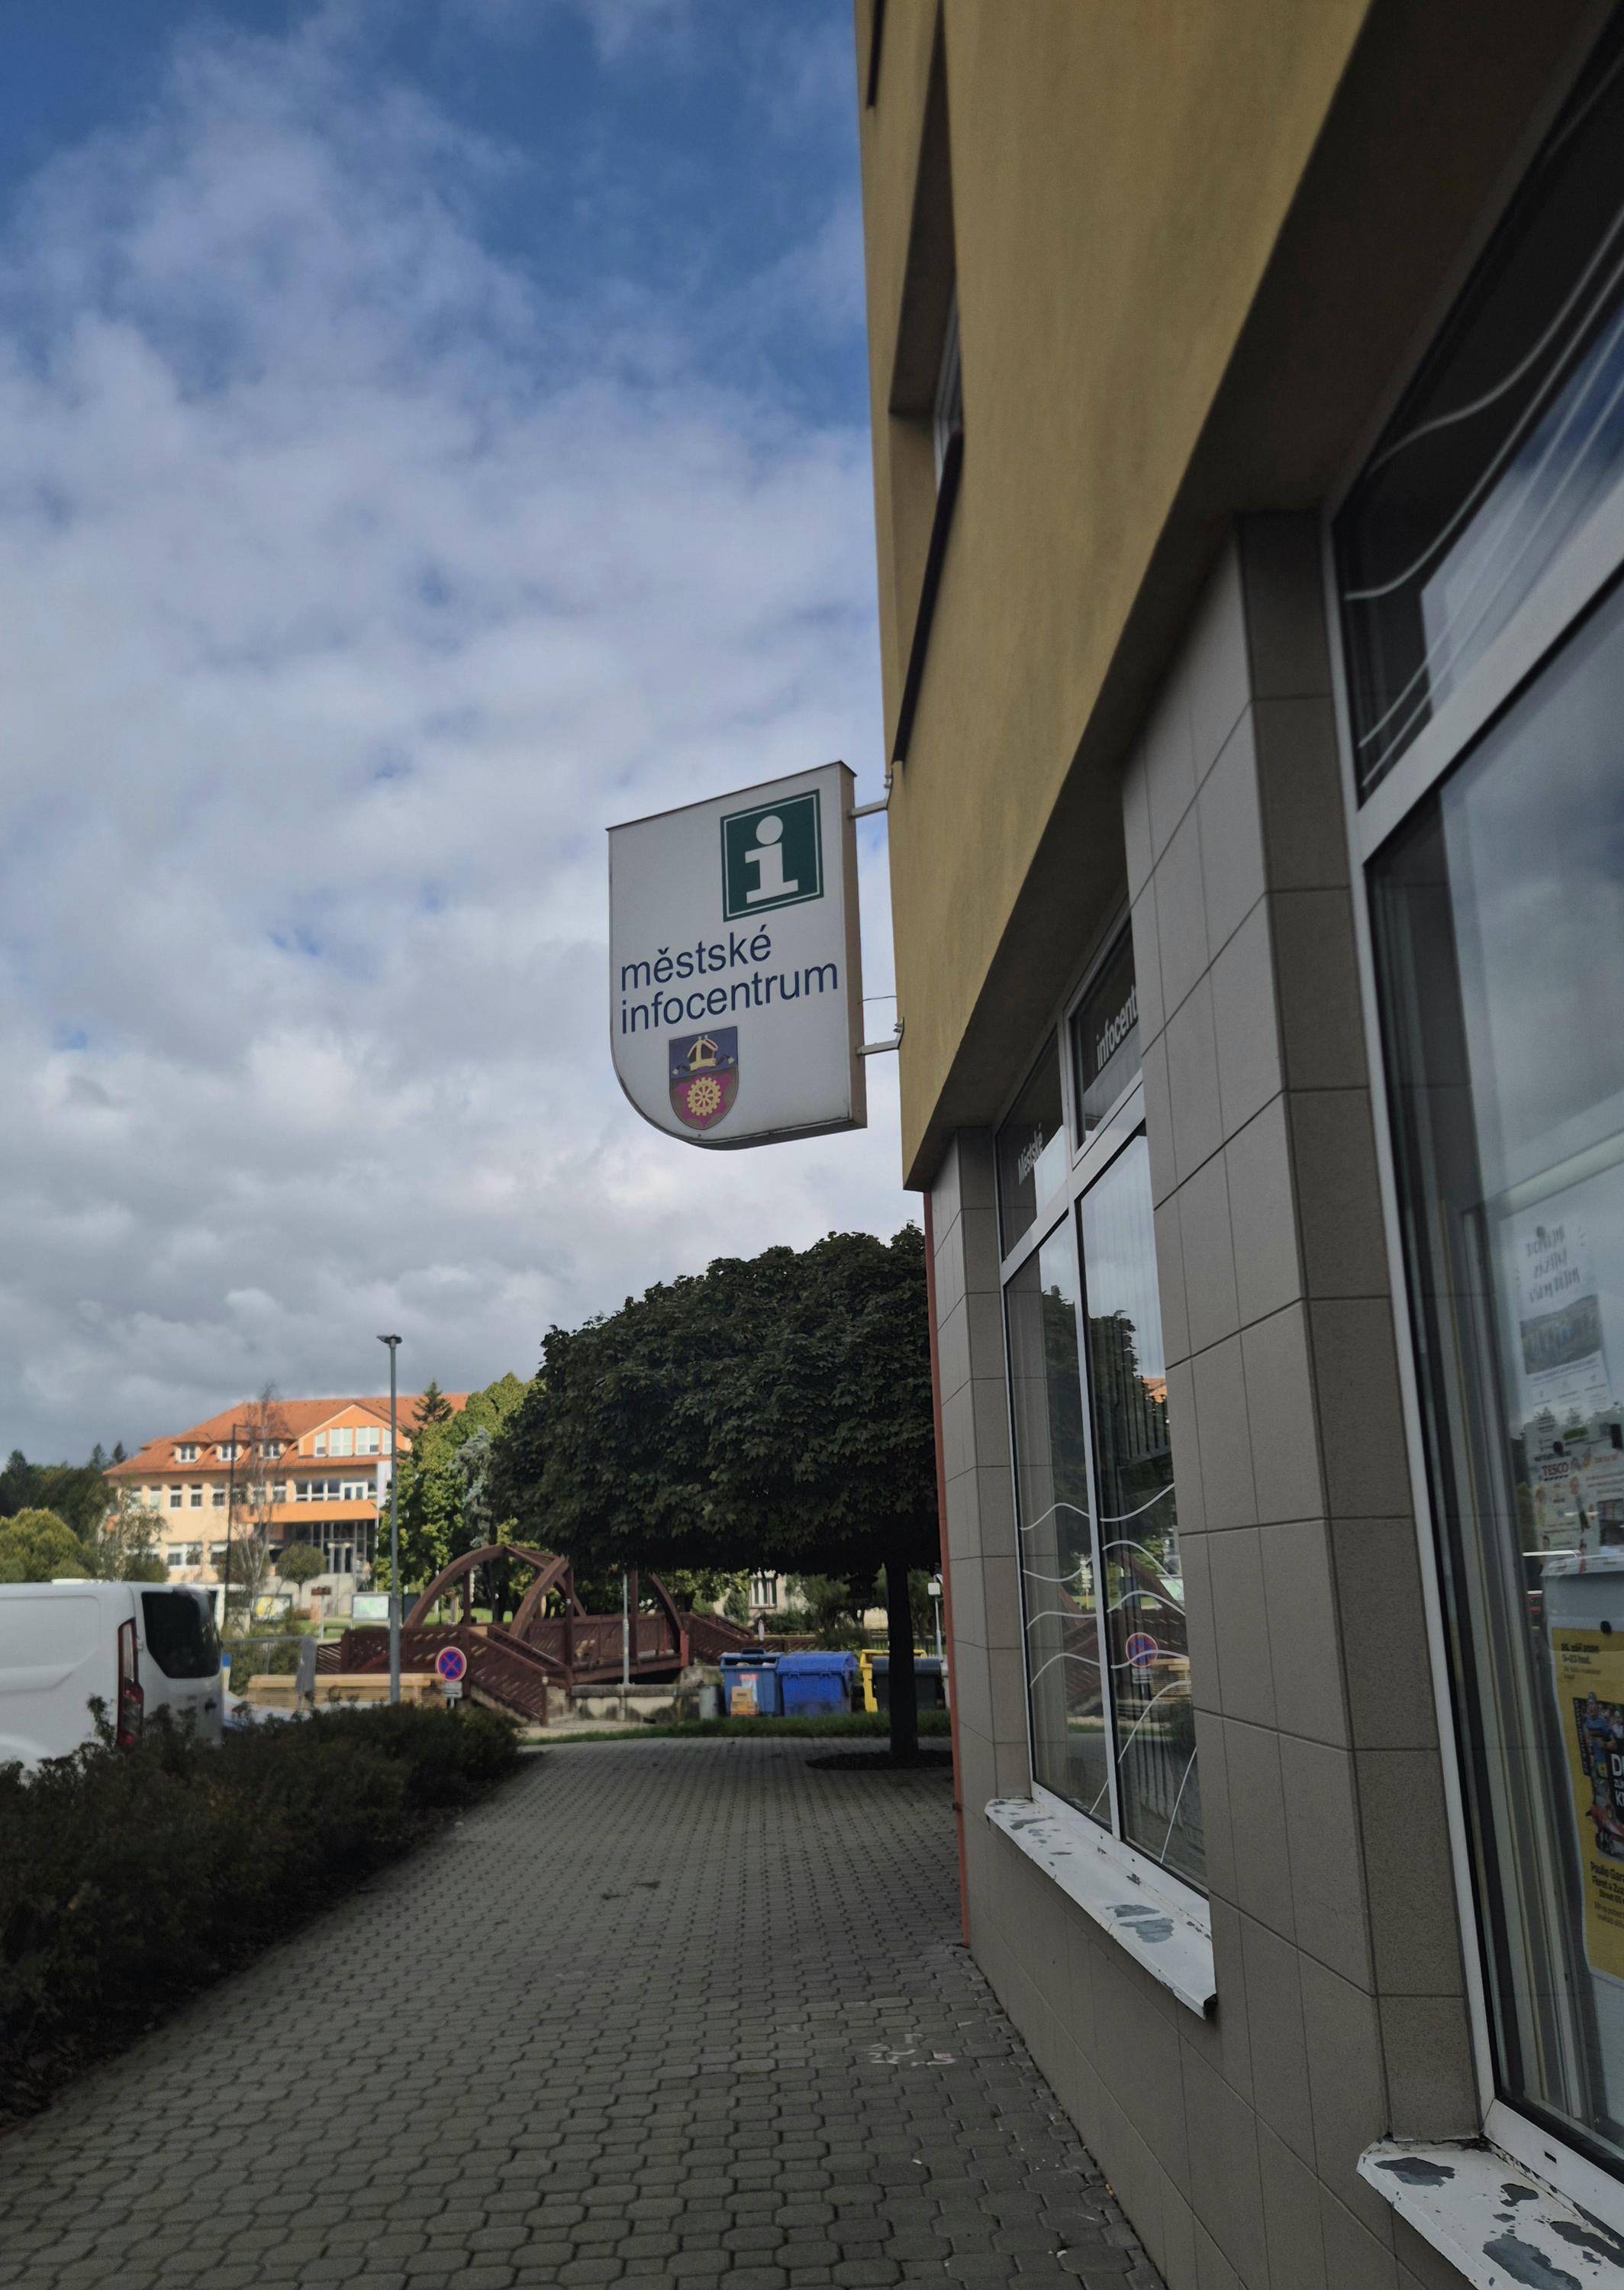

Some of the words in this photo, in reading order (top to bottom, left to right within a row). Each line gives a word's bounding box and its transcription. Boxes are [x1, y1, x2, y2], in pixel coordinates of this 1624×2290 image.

[620, 924, 772, 992] městské
[621, 963, 838, 1035] infocentrum
[1542, 1462, 1569, 1477] TESCO
